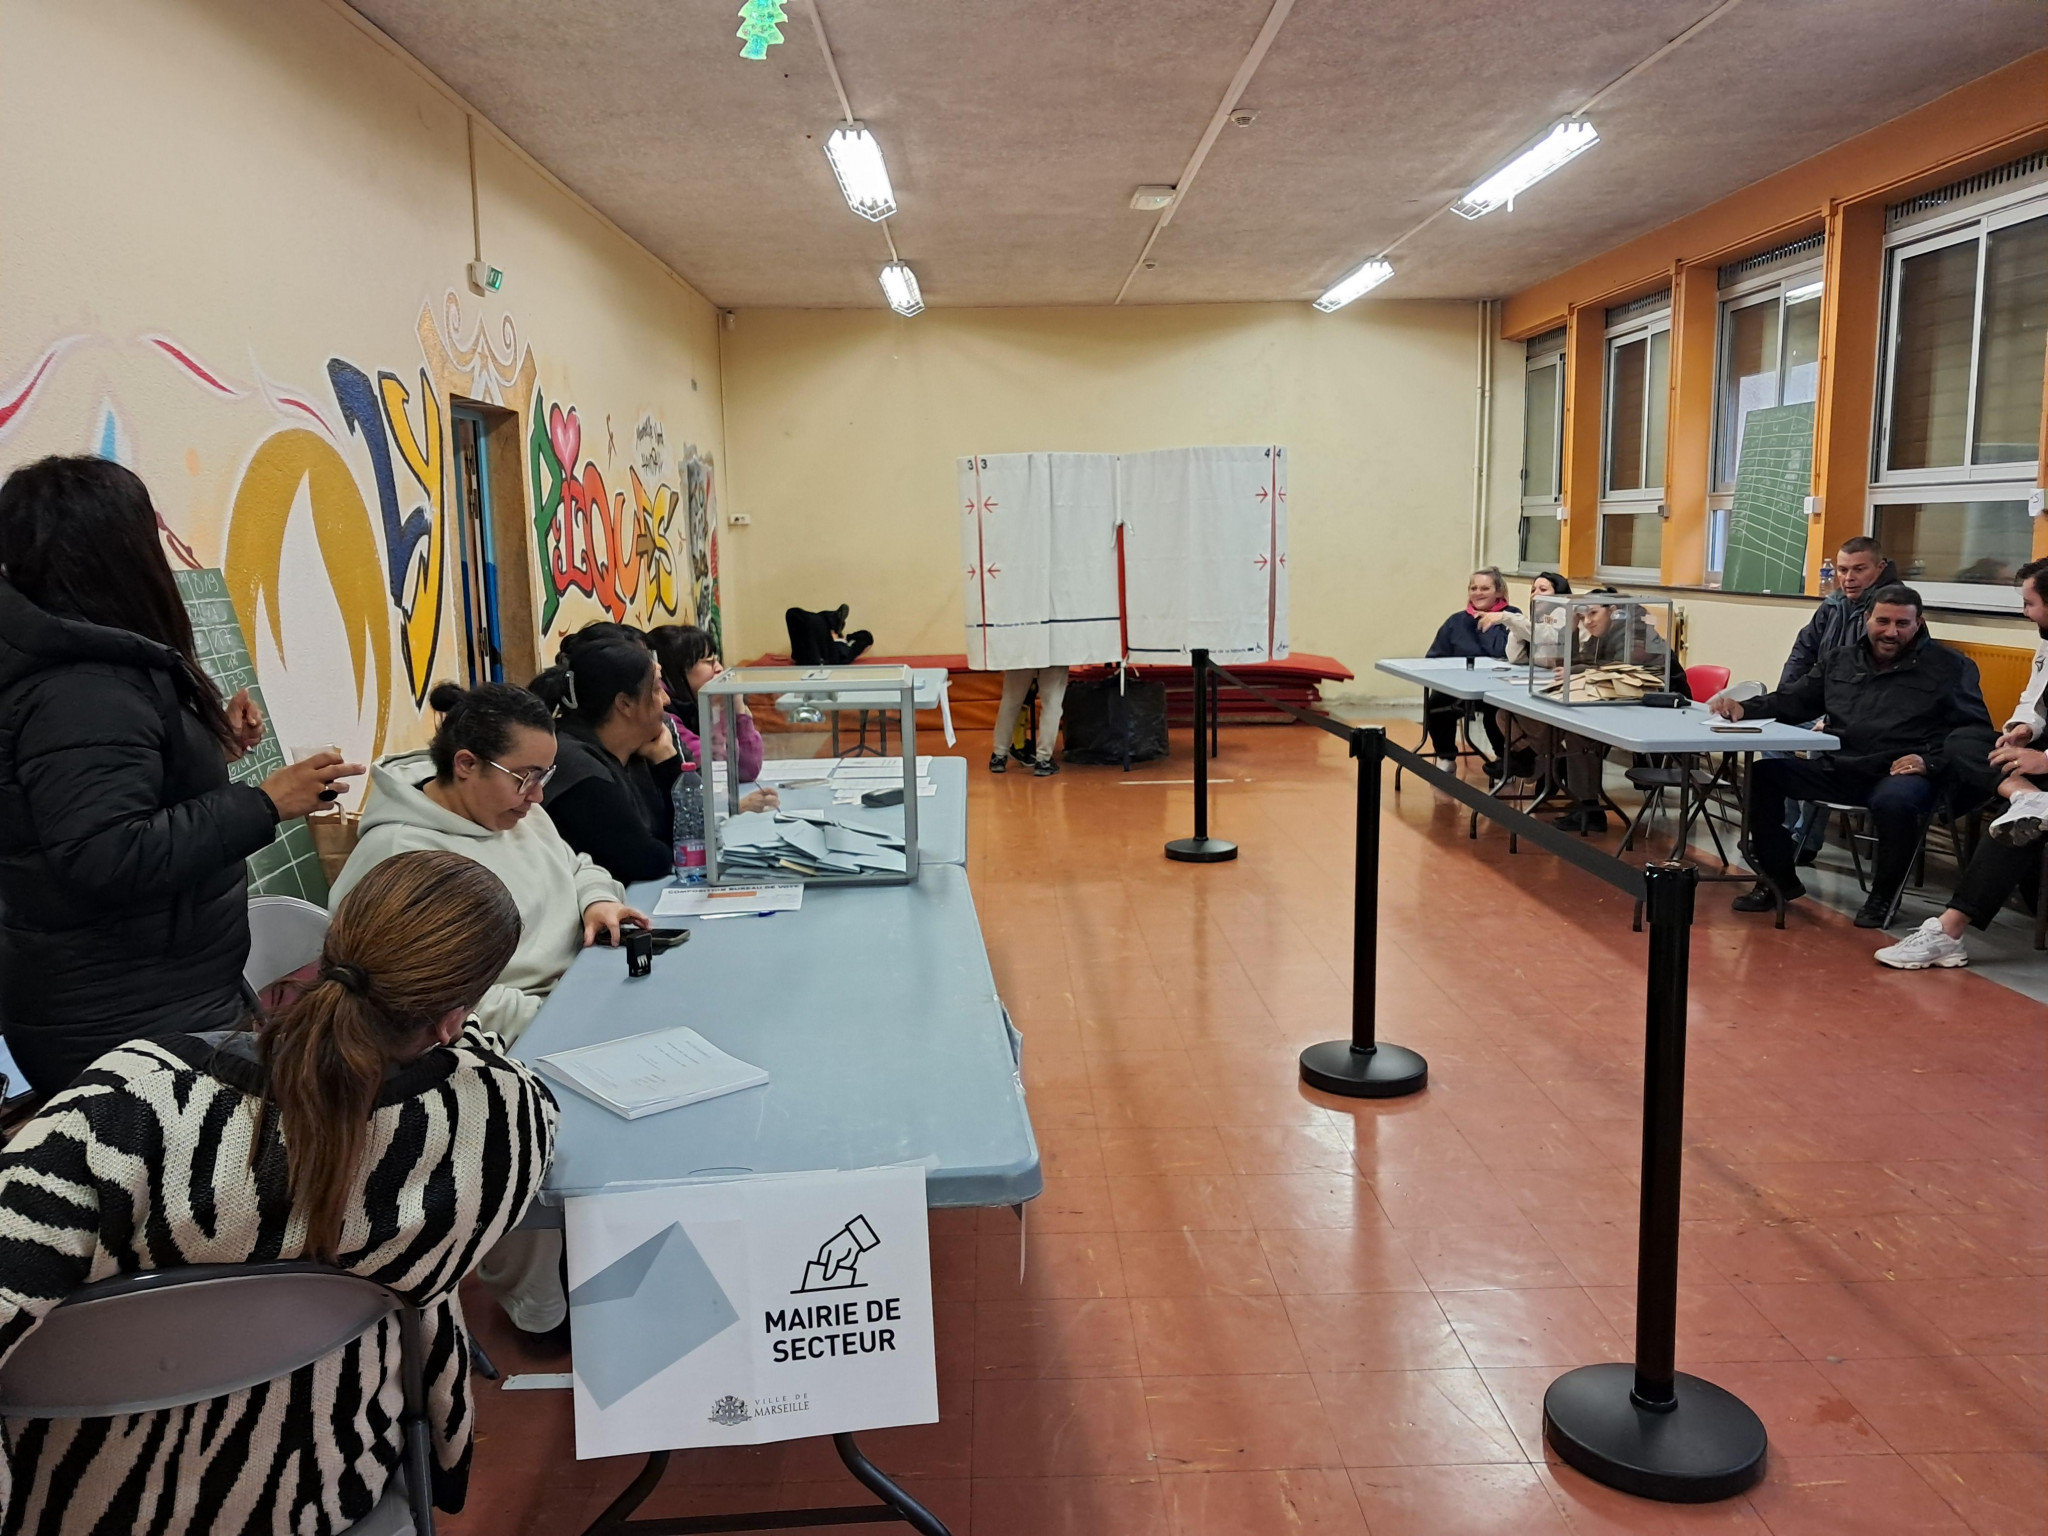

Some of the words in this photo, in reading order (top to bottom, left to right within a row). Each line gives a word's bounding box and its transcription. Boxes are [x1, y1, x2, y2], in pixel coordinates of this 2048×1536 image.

[1264, 448, 1271, 459] 4
[1276, 448, 1281, 459] 4
[967, 460, 974, 470] 3
[981, 459, 988, 469] 3
[765, 1302, 859, 1333] MAIRIE
[866, 1298, 901, 1323] DE
[773, 1329, 896, 1363] SECTEUR
[755, 1395, 787, 1406] VILLE
[795, 1393, 808, 1401] DE
[754, 1401, 810, 1418] MARSEILLE
